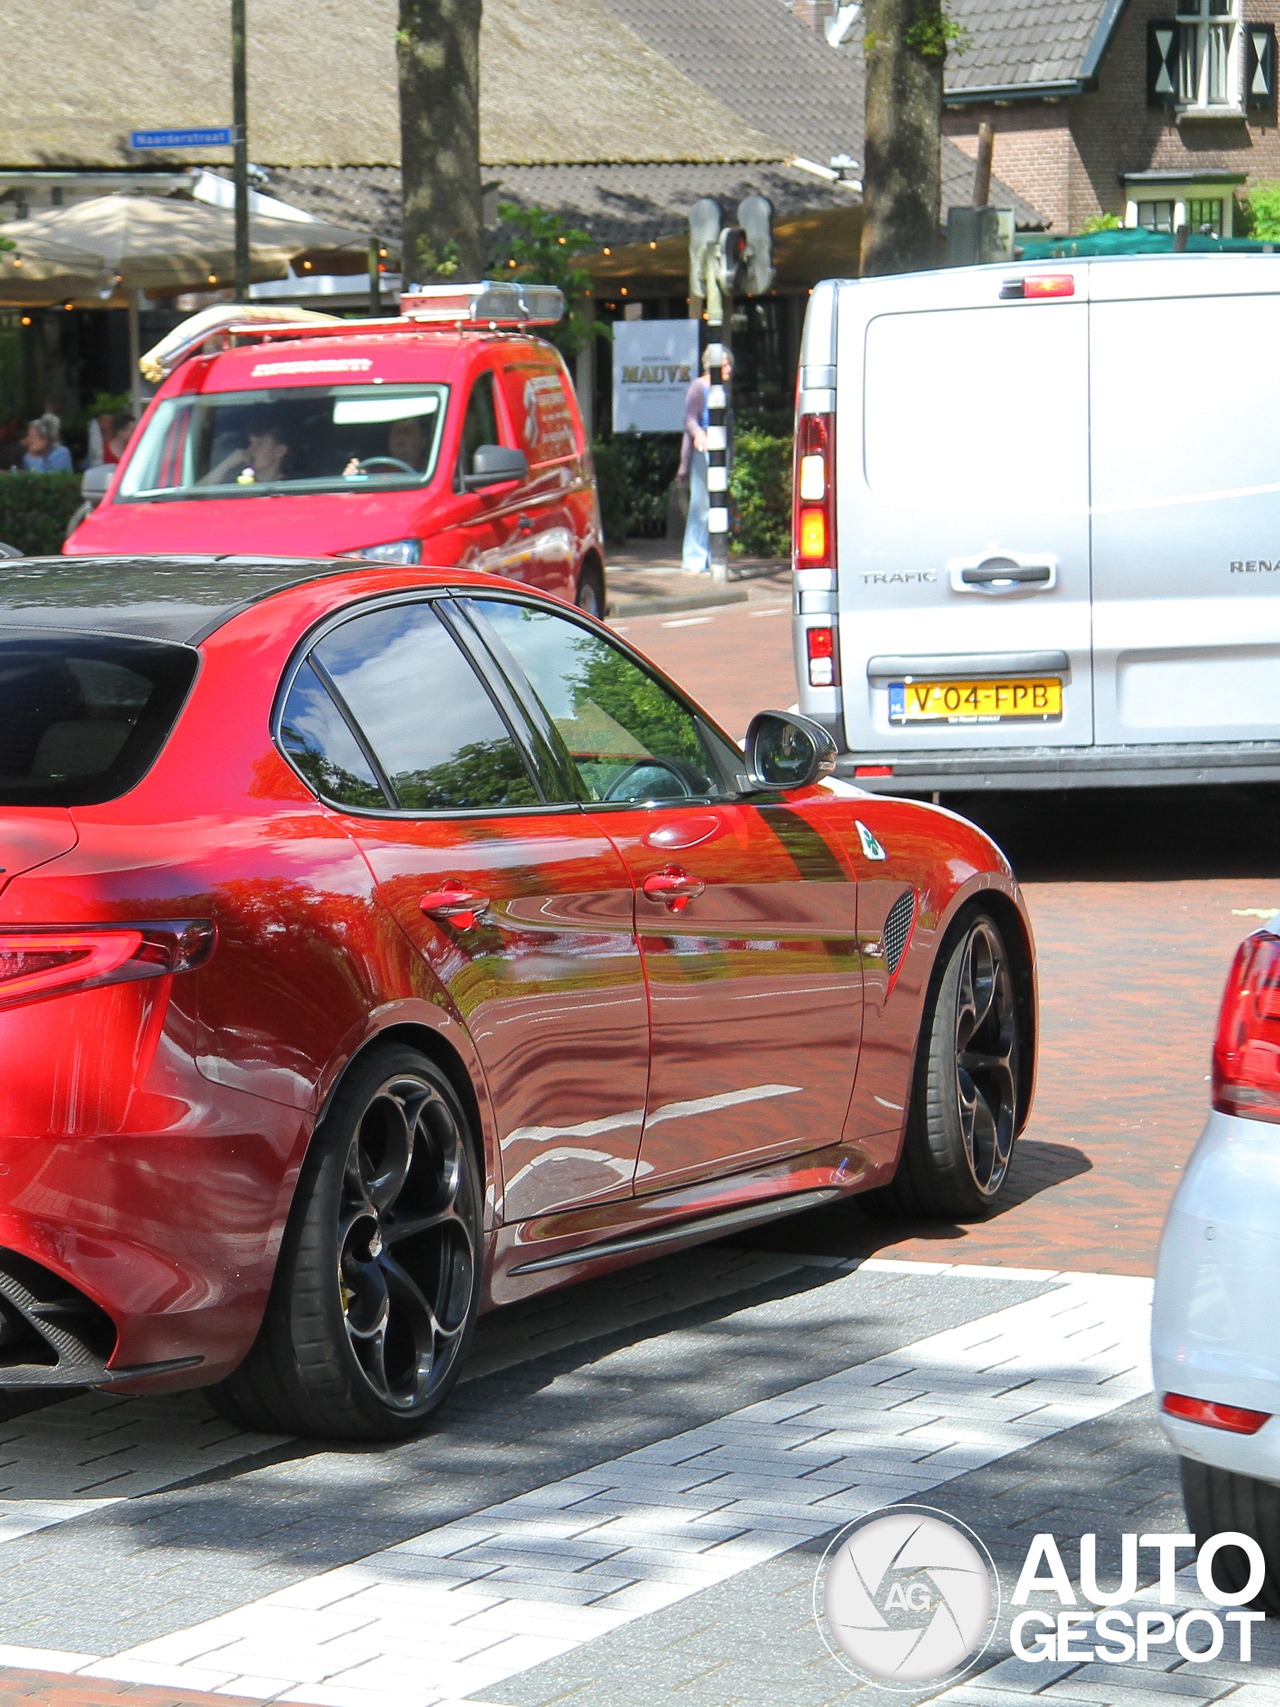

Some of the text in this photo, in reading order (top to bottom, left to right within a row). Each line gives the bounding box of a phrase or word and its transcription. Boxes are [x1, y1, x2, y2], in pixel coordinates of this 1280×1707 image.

[621, 365, 691, 383] MAUVE
[858, 568, 938, 584] TRAFIC
[891, 684, 1049, 713] NL V-04-FPB
